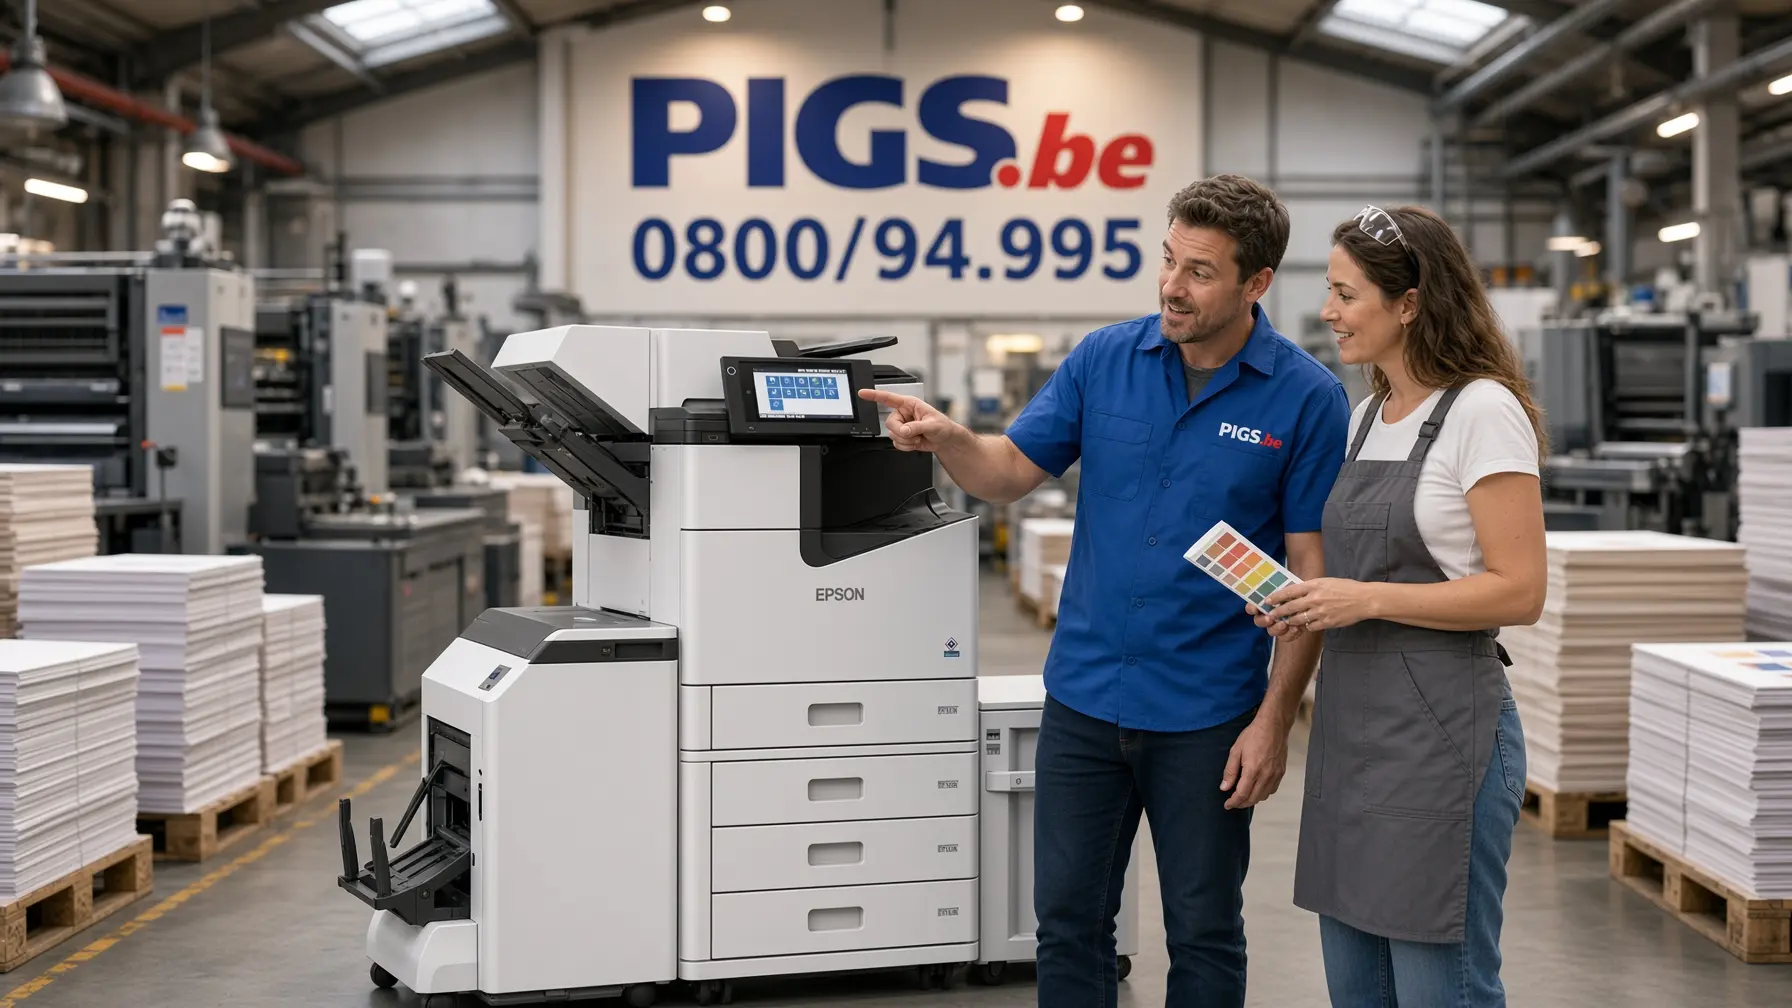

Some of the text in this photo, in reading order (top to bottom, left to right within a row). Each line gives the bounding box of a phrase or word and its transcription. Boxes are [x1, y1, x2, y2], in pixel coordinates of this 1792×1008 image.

[631, 74, 1154, 190] PIGS.be
[631, 217, 1143, 283] 0800/94.995
[1218, 422, 1283, 449] PIGS.be
[815, 587, 864, 601] EPSON
